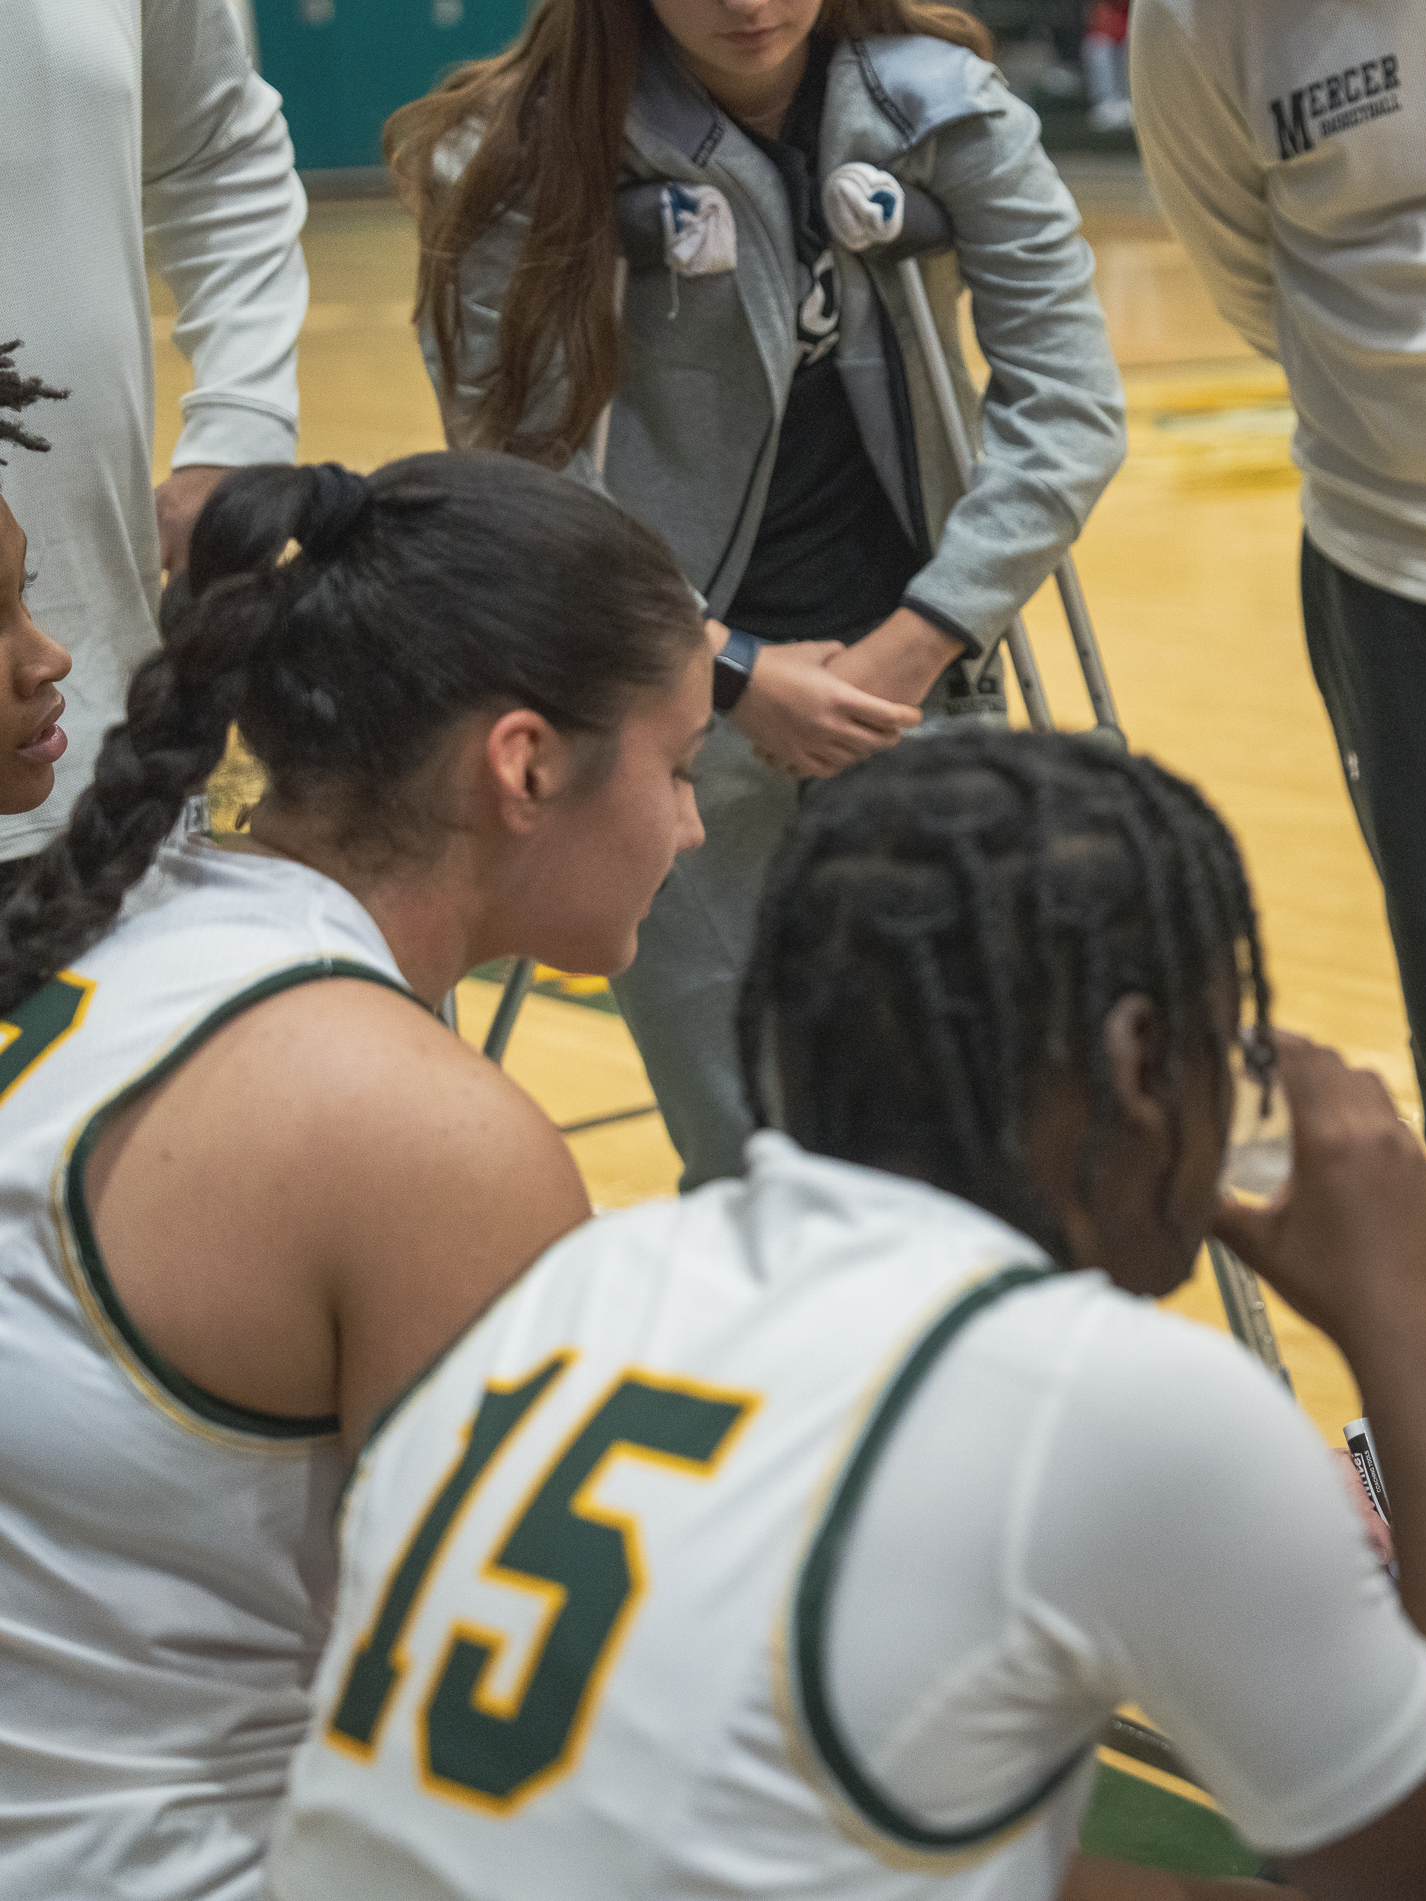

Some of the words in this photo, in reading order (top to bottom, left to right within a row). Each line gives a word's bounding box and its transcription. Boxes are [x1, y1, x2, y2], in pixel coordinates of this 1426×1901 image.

[1270, 54, 1400, 161] MERCER
[1364, 1450, 1373, 1467] TOOLS
[1369, 1467, 1382, 1493] COACHING
[323, 1346, 765, 1822] 15
